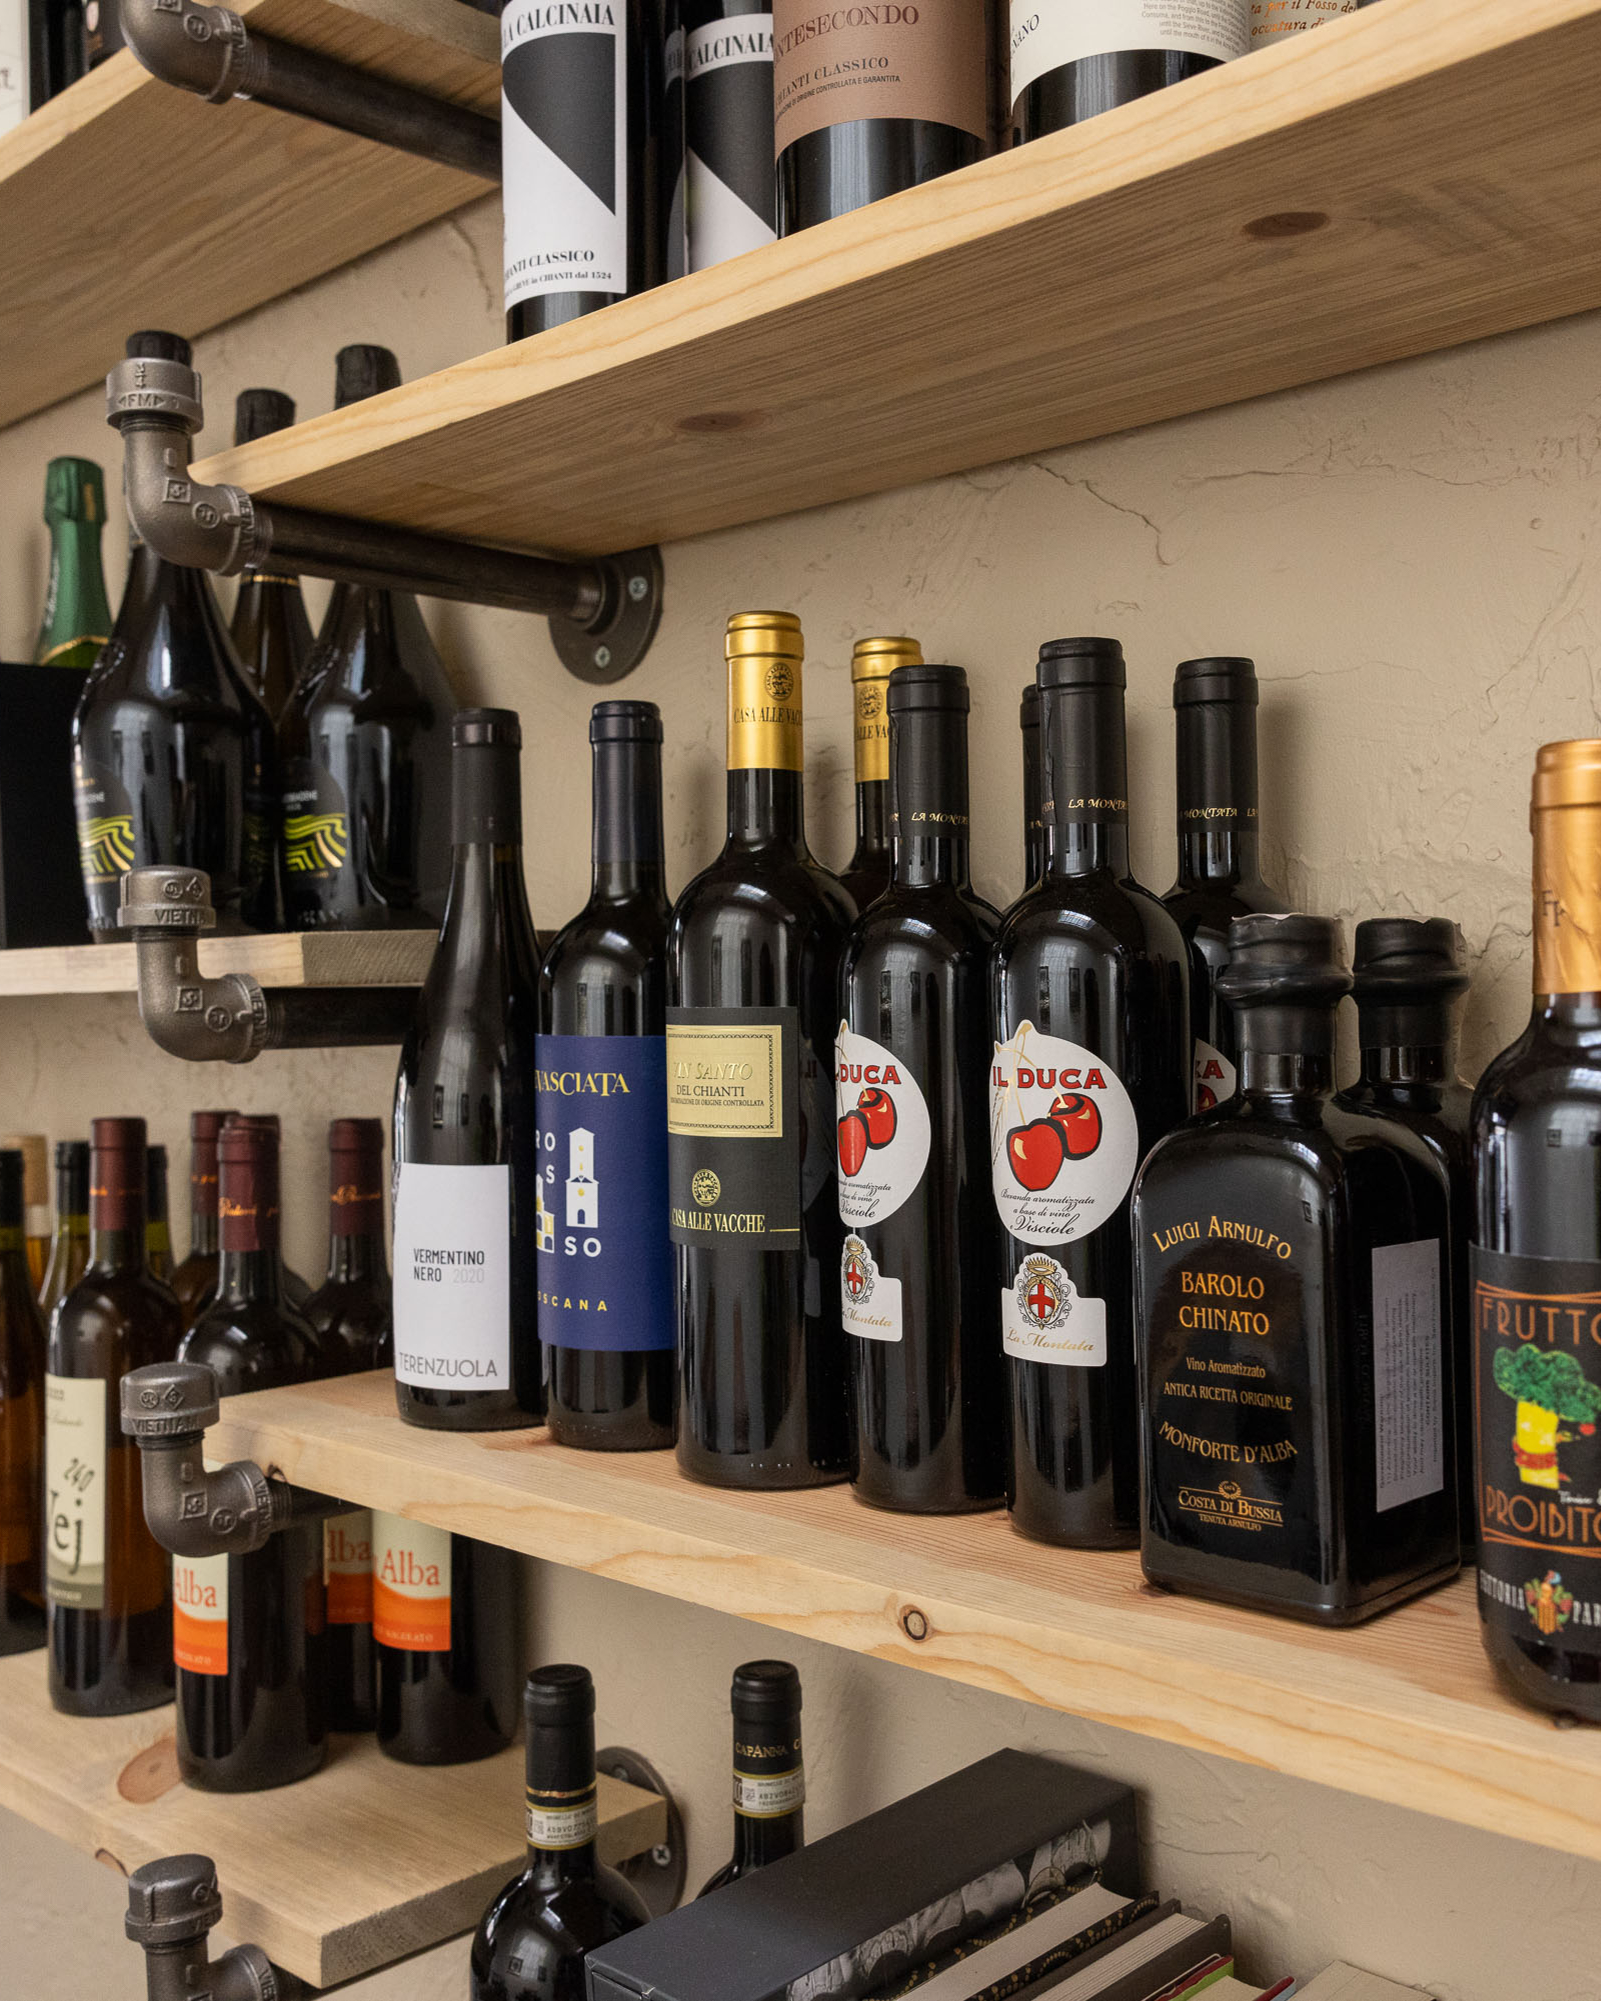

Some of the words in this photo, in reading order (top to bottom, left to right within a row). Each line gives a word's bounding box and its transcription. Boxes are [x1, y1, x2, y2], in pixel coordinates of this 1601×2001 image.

[516, 3, 616, 36] CALCINAIA
[1264, 0, 1289, 18] per
[814, 56, 889, 80] CLASSICO
[815, 78, 857, 95] CONTROLLATA
[862, 74, 901, 84] GARANTITA
[529, 249, 595, 268] CLASSICO
[575, 270, 589, 280] dal
[591, 271, 613, 280] 1524
[733, 707, 757, 724] CASA
[760, 706, 784, 723] ALLE
[1067, 798, 1085, 809] LA
[911, 811, 927, 822] LA
[695, 1062, 754, 1080] SANTO
[840, 1064, 902, 1085] DUCA
[992, 1065, 1010, 1088] IL
[1017, 1068, 1107, 1090] DUCA
[676, 1084, 692, 1096] DEL
[693, 1085, 745, 1097] CHIANTI
[701, 1099, 722, 1107] ORIGINE
[722, 1099, 765, 1107] CONTROLLATA
[857, 1194, 873, 1202] vino
[1032, 1193, 1096, 1211] aromatizzata
[1019, 1201, 1038, 1217] base
[1038, 1205, 1049, 1217] di
[1049, 1208, 1071, 1218] vino
[672, 1208, 687, 1229] CASA
[687, 1210, 713, 1231] ALLE
[713, 1213, 766, 1233] VACCHE
[1014, 1213, 1081, 1236] Visciole
[413, 1247, 486, 1266] VERMENTINO
[564, 1236, 602, 1258] SO
[413, 1266, 443, 1283] NERO
[452, 1268, 486, 1284] 2020
[1181, 1271, 1266, 1300] BAROLO
[1178, 1305, 1271, 1336] CHINATO
[1006, 1326, 1021, 1344] La
[1022, 1330, 1096, 1352] Montata
[399, 1352, 499, 1379] TERENZUOLA
[1186, 1356, 1207, 1372] Vino
[1208, 1359, 1267, 1379] Aromatizzato
[1163, 1381, 1198, 1399] ANTICA
[1199, 1385, 1239, 1403] RICETTA
[1240, 1390, 1294, 1412] ORIGINALE
[1158, 1421, 1240, 1462] MONFORTE
[1244, 1440, 1298, 1463] D'ALBA
[1178, 1490, 1218, 1511] COSTA
[1220, 1500, 1234, 1512] DI
[1238, 1500, 1283, 1523] BUSSIA
[1199, 1513, 1227, 1526] TENUTA
[329, 1530, 371, 1563] lba
[381, 1547, 442, 1587] Alba
